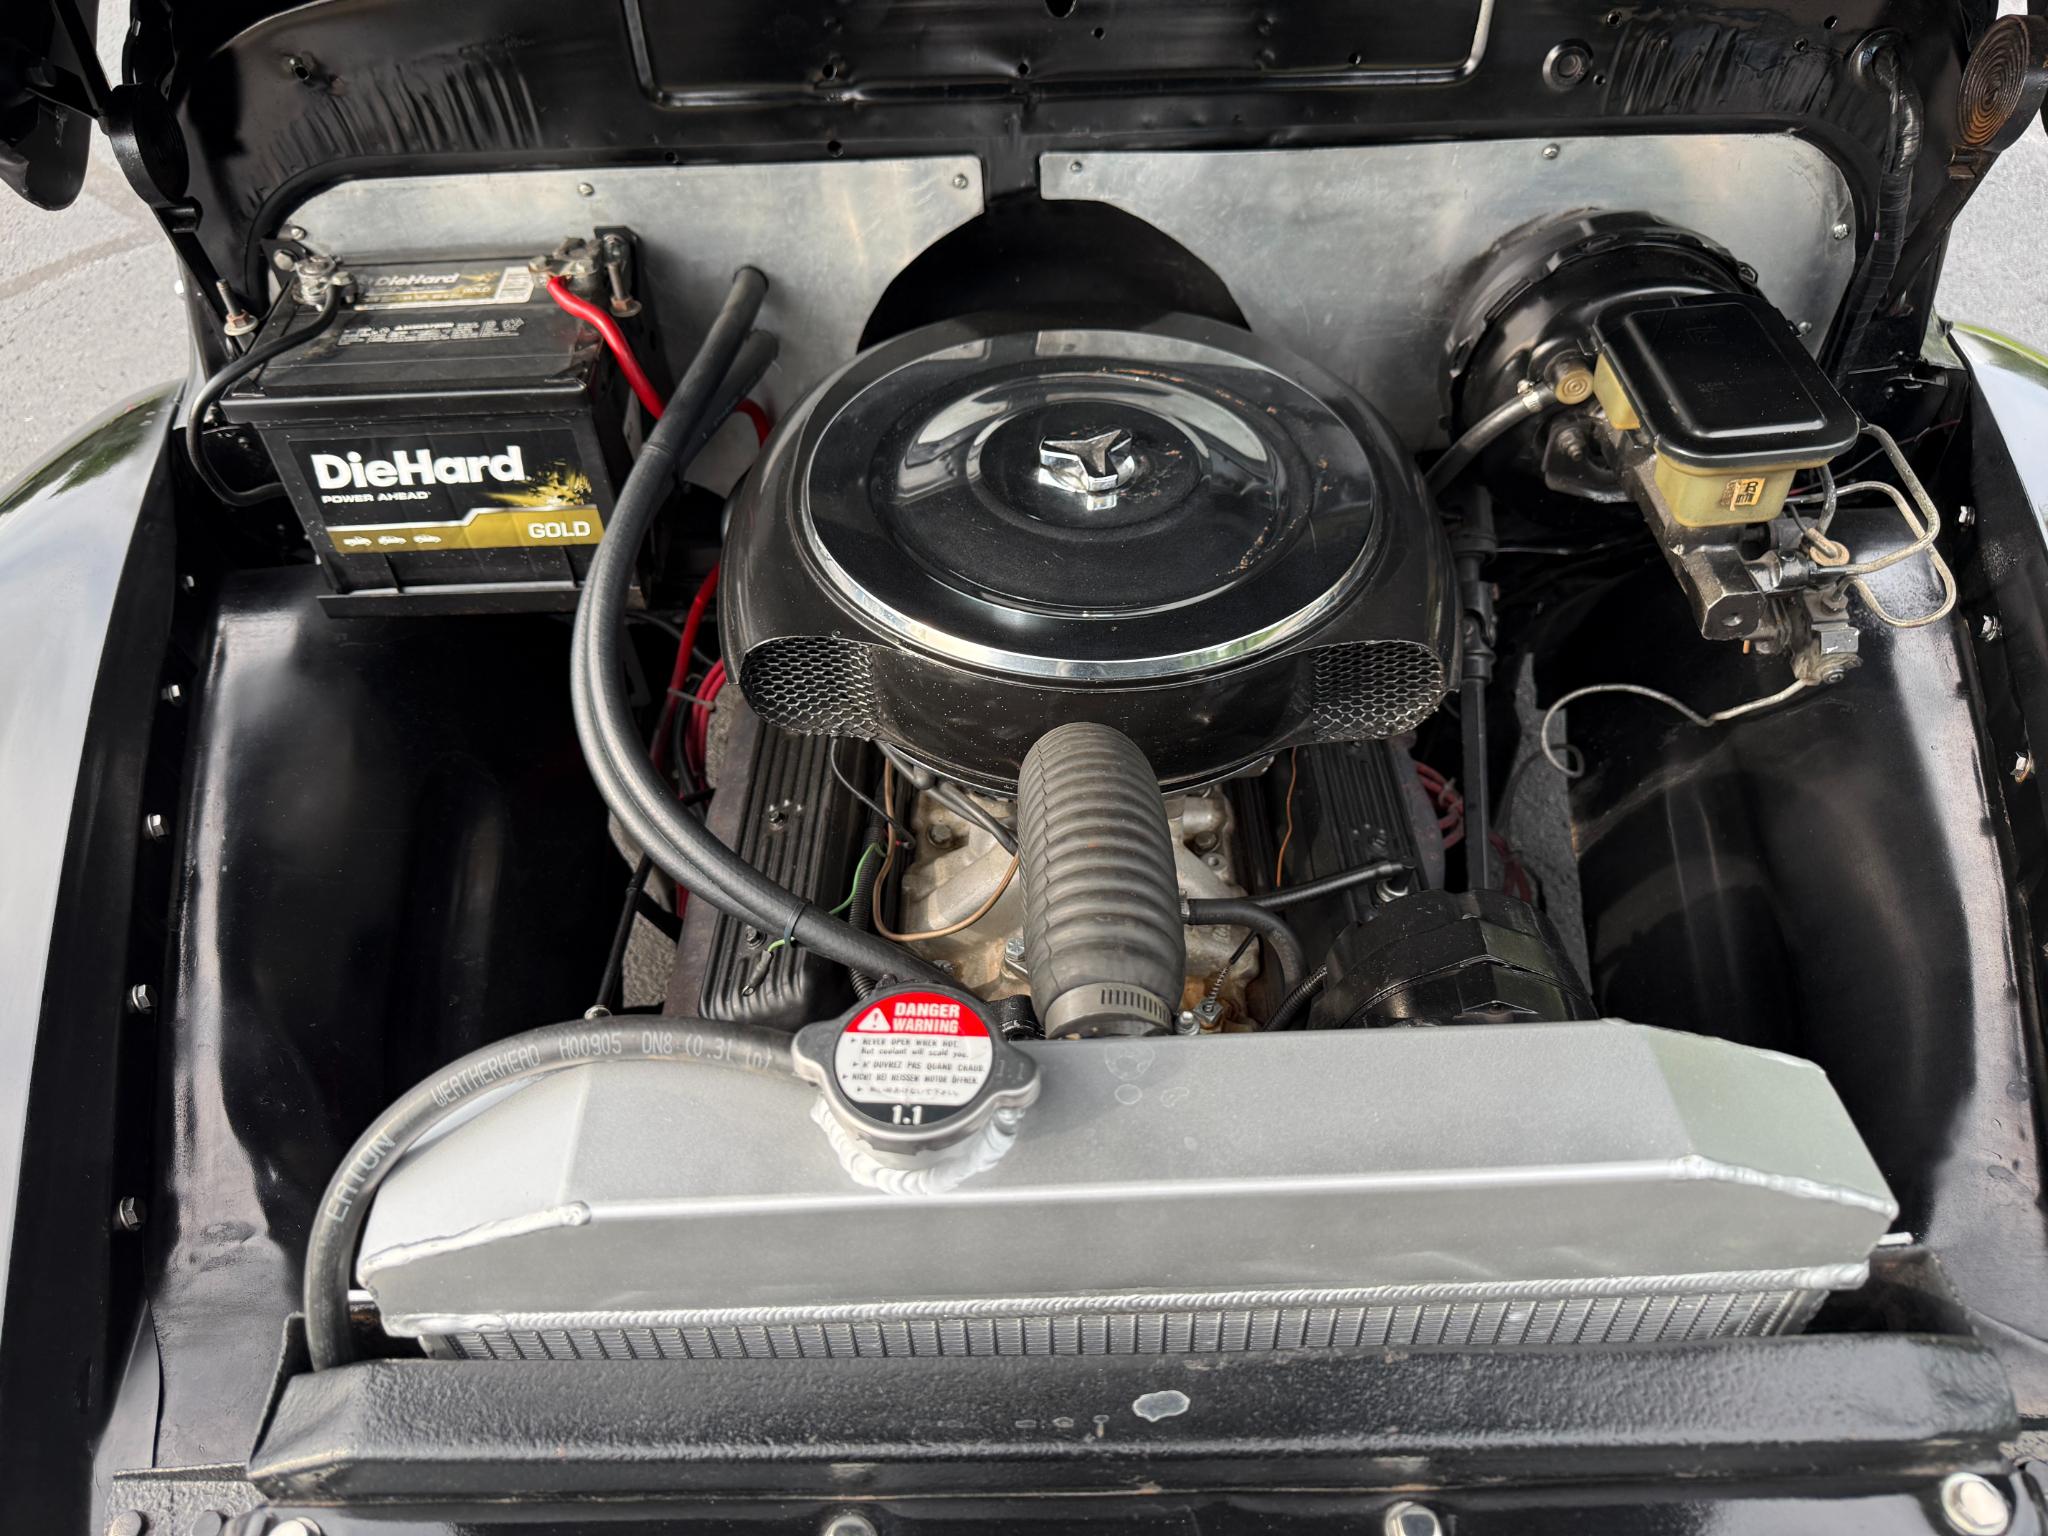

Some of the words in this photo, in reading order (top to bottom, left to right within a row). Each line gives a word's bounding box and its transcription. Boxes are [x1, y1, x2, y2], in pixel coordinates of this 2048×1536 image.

[374, 272, 460, 287] DieHard
[310, 445, 526, 490] DieHard
[320, 493, 374, 505] POWER
[377, 491, 430, 502] AHEAD
[528, 520, 591, 539] GOLD
[894, 1002, 960, 1019] DANGER
[892, 1017, 959, 1034] WARNING
[862, 1038, 886, 1046] NEVER
[891, 1038, 911, 1046] OPEN
[915, 1039, 938, 1047] WHEN
[879, 1047, 907, 1055] coolant
[911, 1048, 924, 1056] will
[928, 1049, 949, 1057] scald
[873, 1060, 903, 1069] OUVREZ
[907, 1061, 922, 1070] PAS
[926, 1062, 952, 1071] QUAND
[892, 1104, 923, 1126] 1.1
[325, 1133, 397, 1222] EATON
[430, 1043, 541, 1108] WEATHERHEAD
[558, 1031, 623, 1059] H00905
[641, 1031, 673, 1054] DN8
